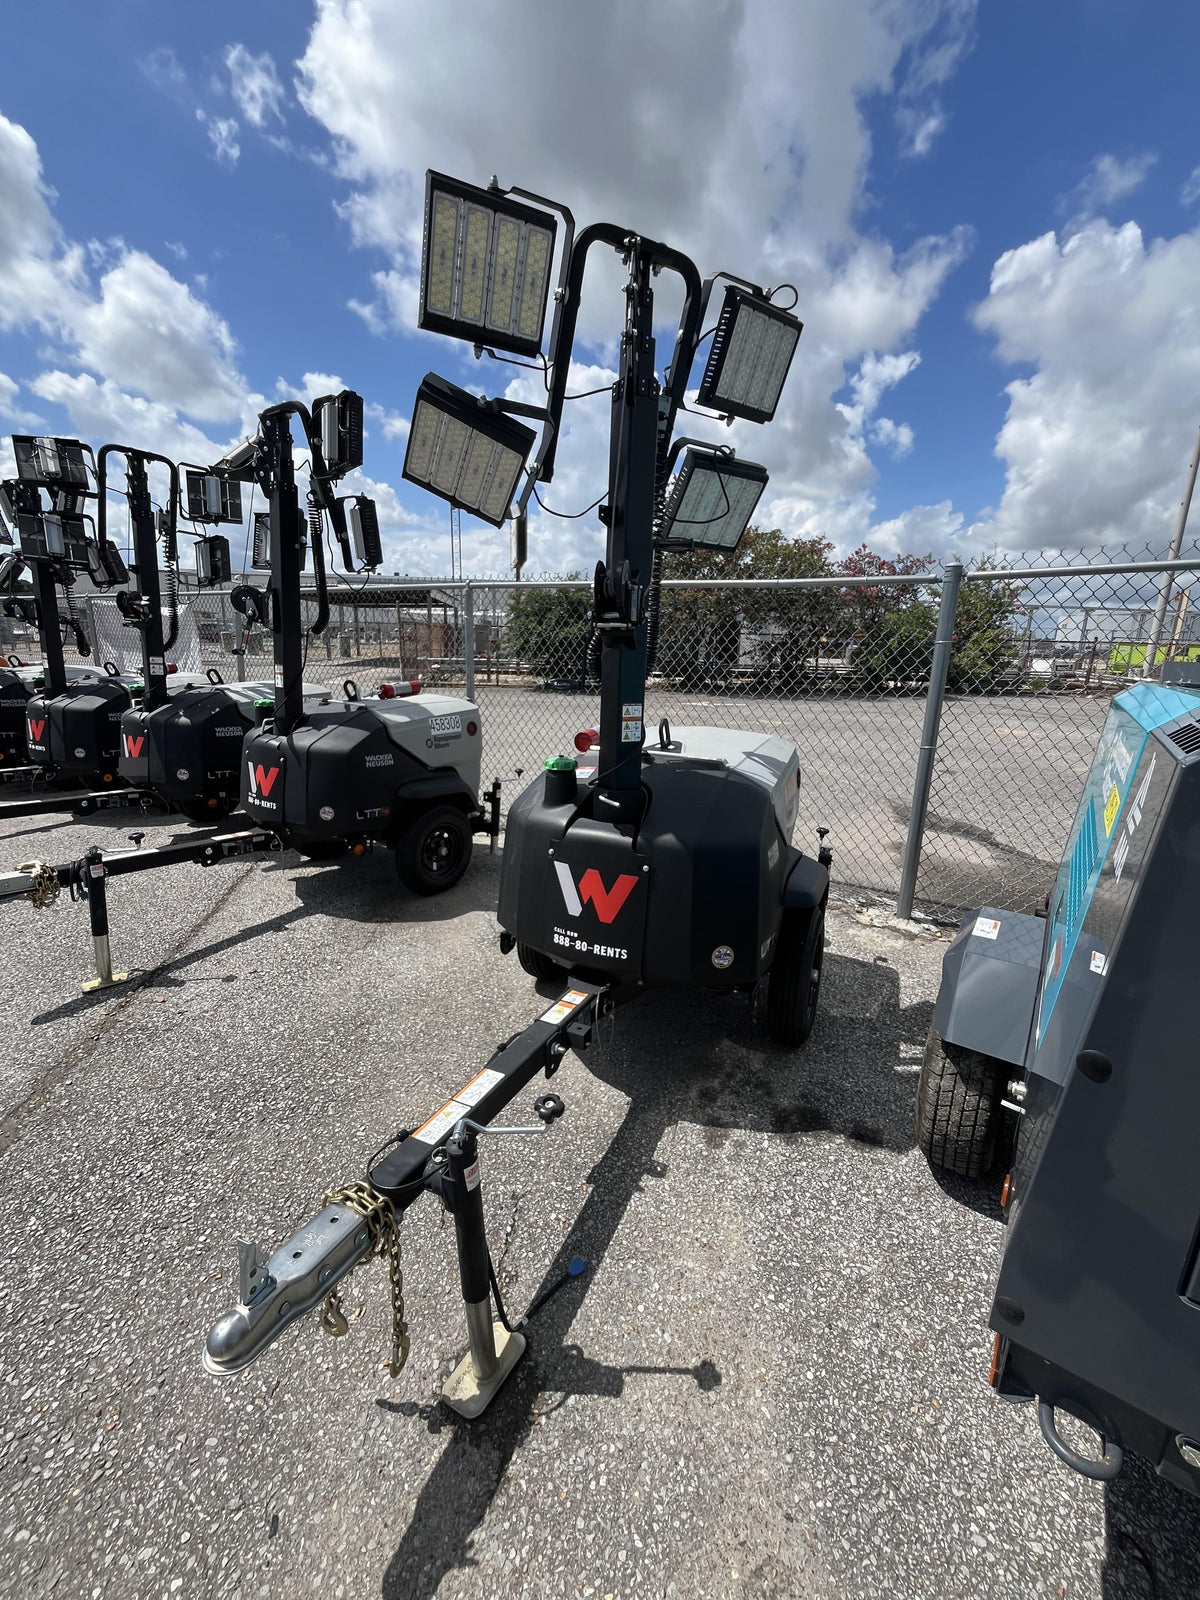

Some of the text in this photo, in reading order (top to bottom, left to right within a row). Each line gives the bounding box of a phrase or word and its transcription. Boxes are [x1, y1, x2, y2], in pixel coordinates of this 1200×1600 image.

[430, 717, 460, 732] 458308
[365, 753, 393, 761] WACKER
[366, 759, 394, 768] NEUSON
[553, 926, 578, 938] CALL NOW
[553, 933, 628, 960] 888-80-RENTS
